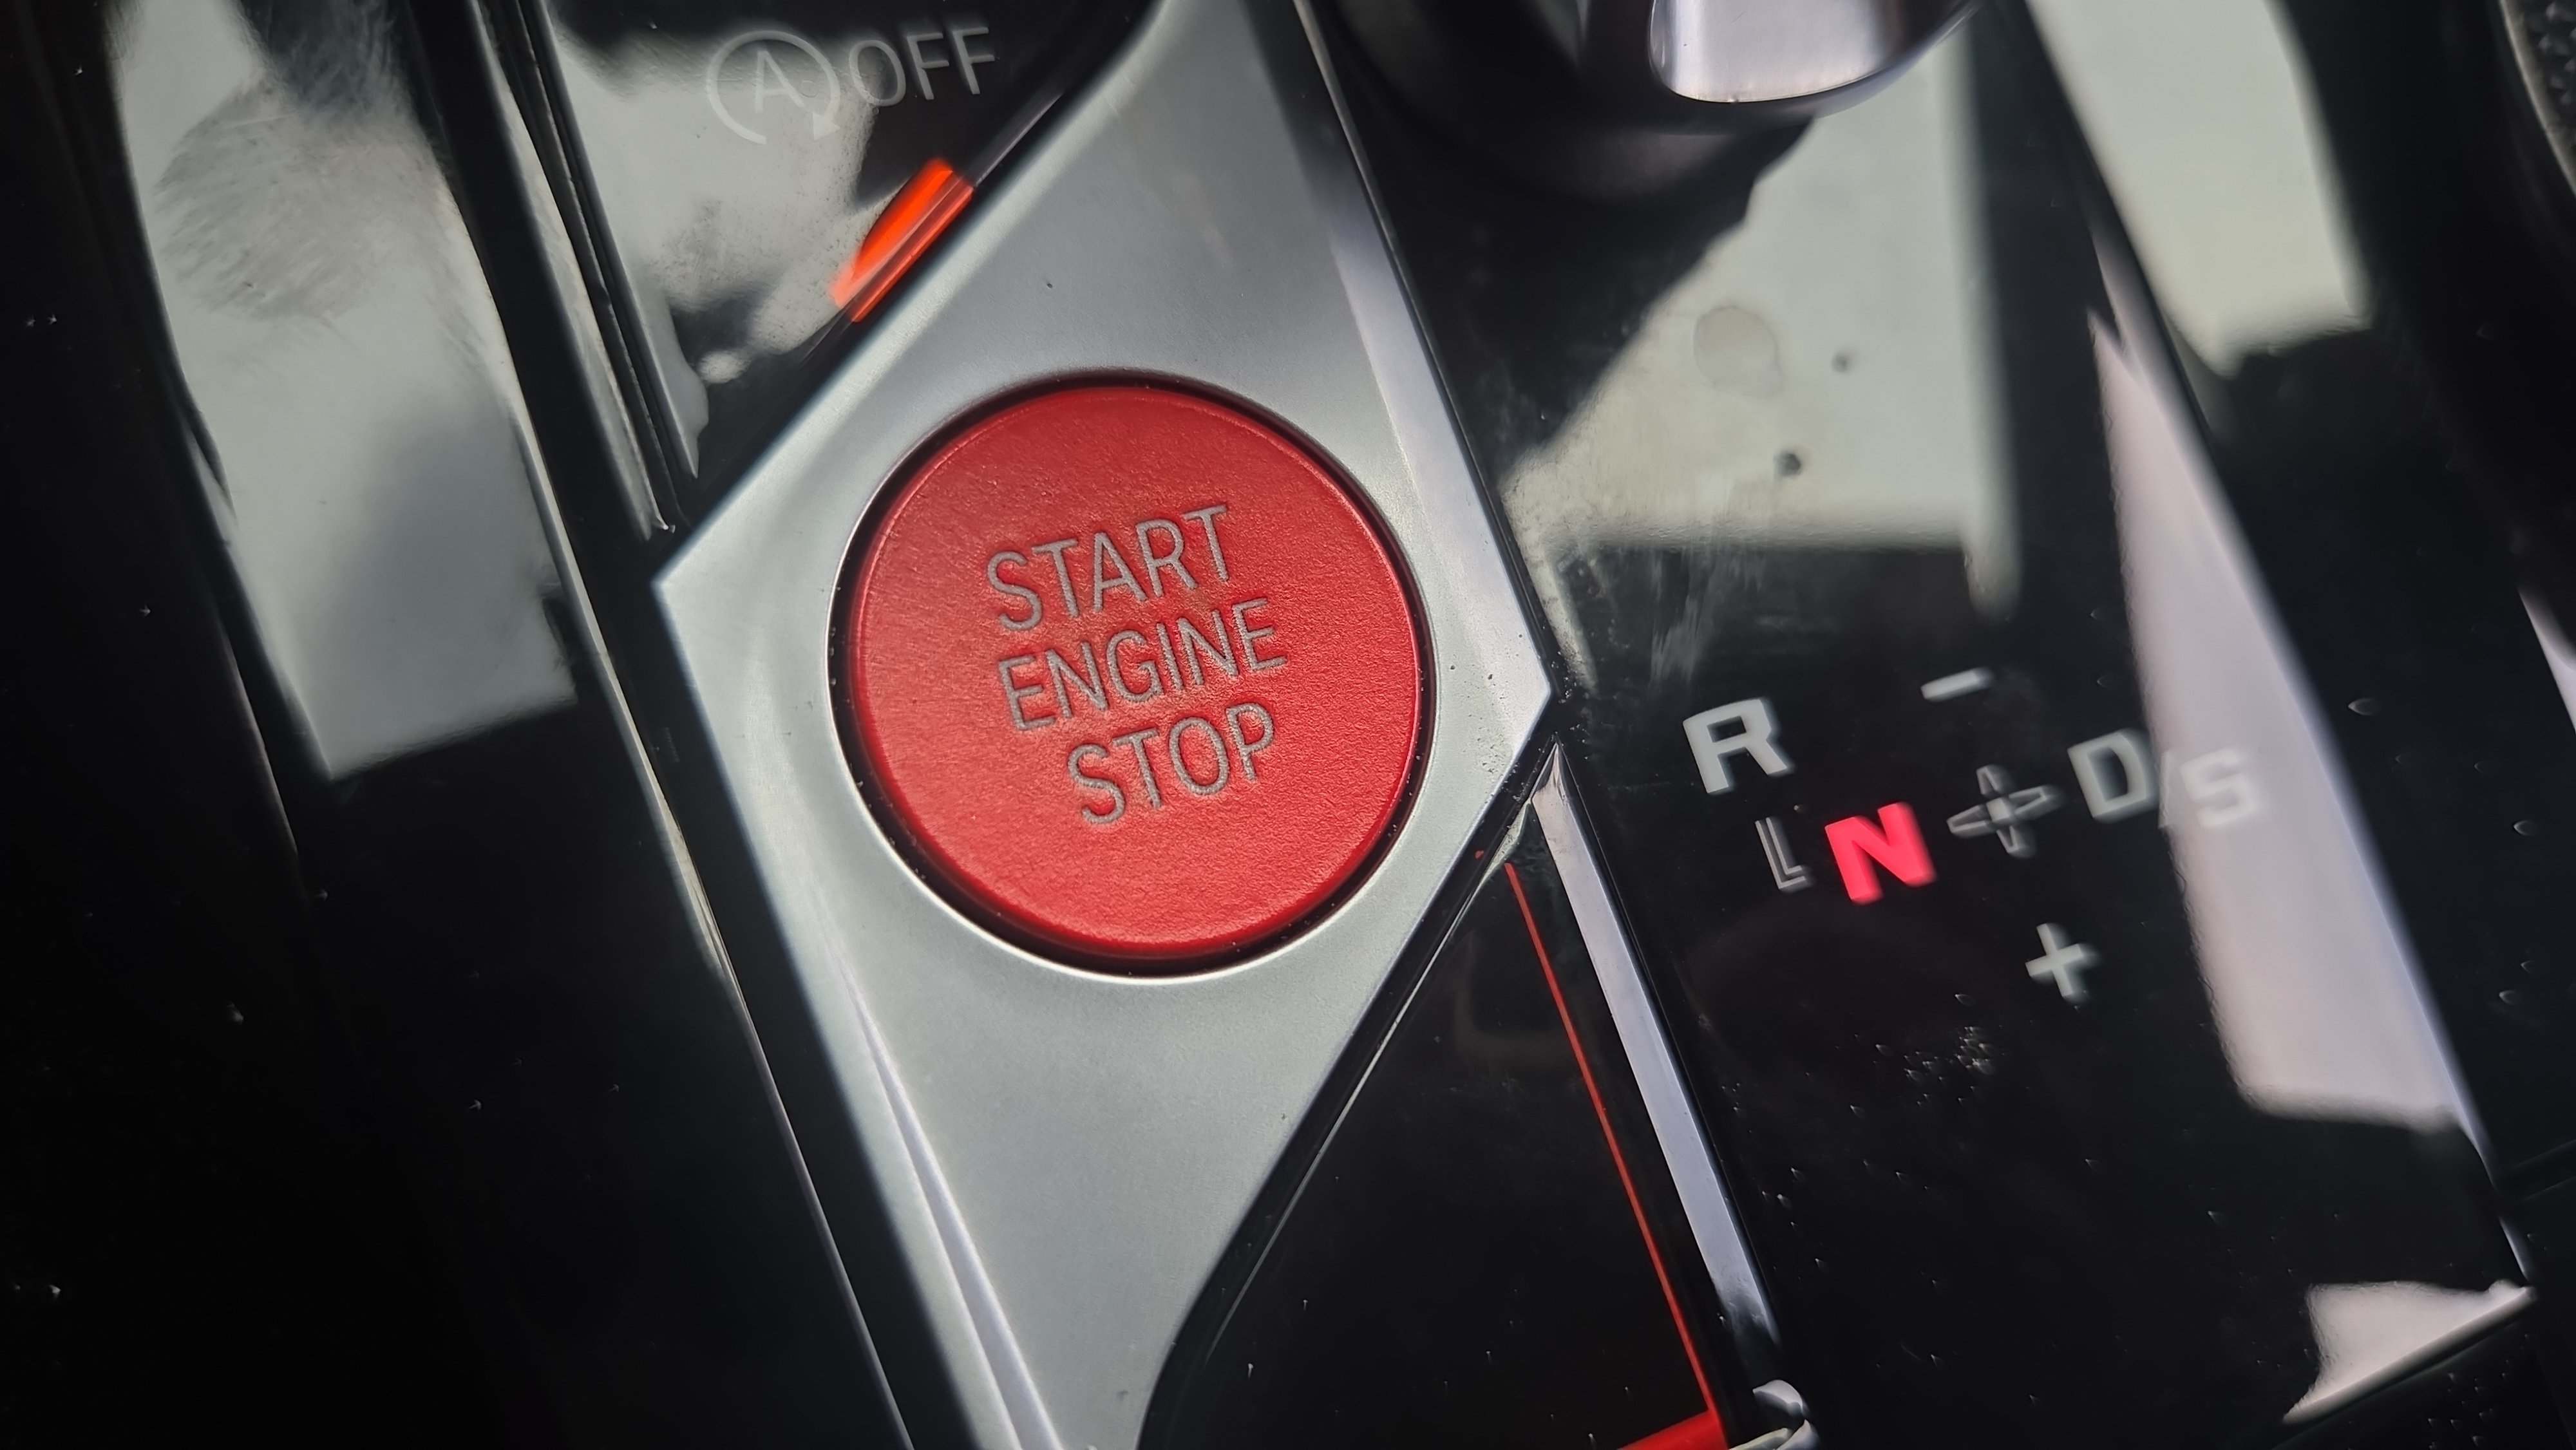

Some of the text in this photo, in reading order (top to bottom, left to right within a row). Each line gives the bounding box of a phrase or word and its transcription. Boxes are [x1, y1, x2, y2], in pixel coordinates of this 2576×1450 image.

[849, 26, 995, 107] OFF
[987, 504, 1229, 631] START
[998, 598, 1287, 731] ENGINE
[1067, 702, 1274, 824] STOP
[1683, 697, 1794, 795] R
[1824, 802, 1937, 904] N
